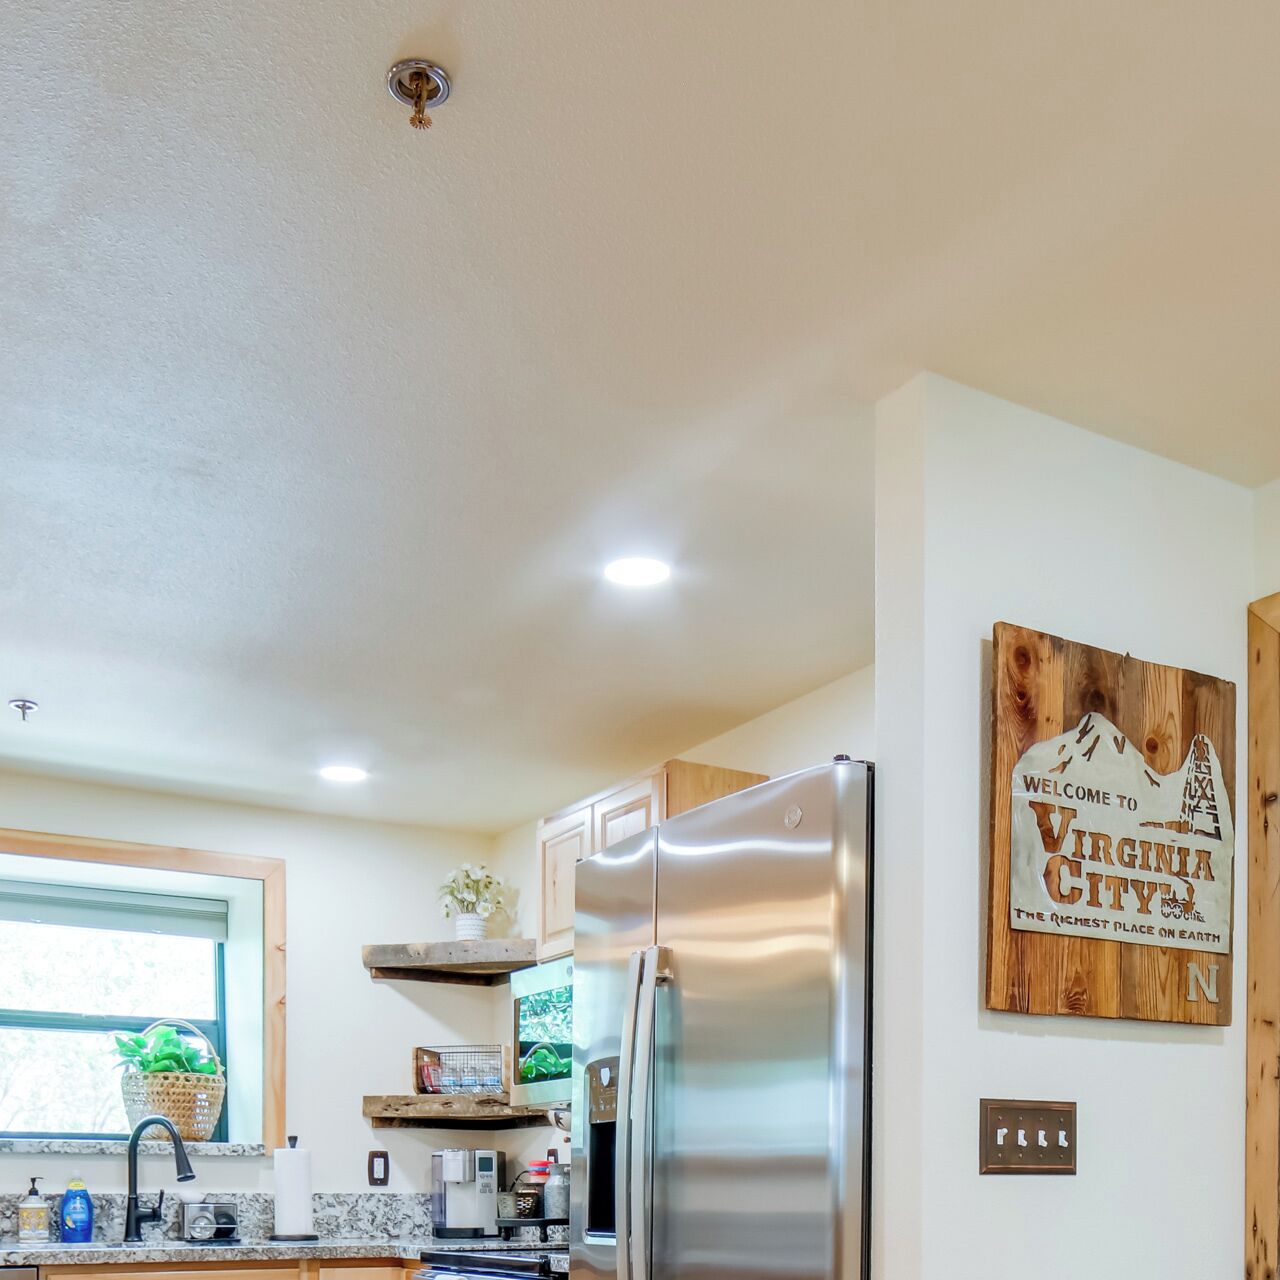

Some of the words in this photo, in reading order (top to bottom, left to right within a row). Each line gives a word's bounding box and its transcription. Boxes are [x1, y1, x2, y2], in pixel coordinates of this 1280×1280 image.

[1022, 775, 1111, 806] WELCOME
[1116, 794, 1138, 812] TO
[1028, 800, 1216, 882] VIRGINIA
[1042, 854, 1158, 915] CITY
[1013, 907, 1046, 922] THE
[1050, 911, 1110, 929] RICHEST
[1113, 921, 1155, 935] PLACE
[1158, 926, 1175, 939] ON
[1178, 931, 1220, 944] EARTH
